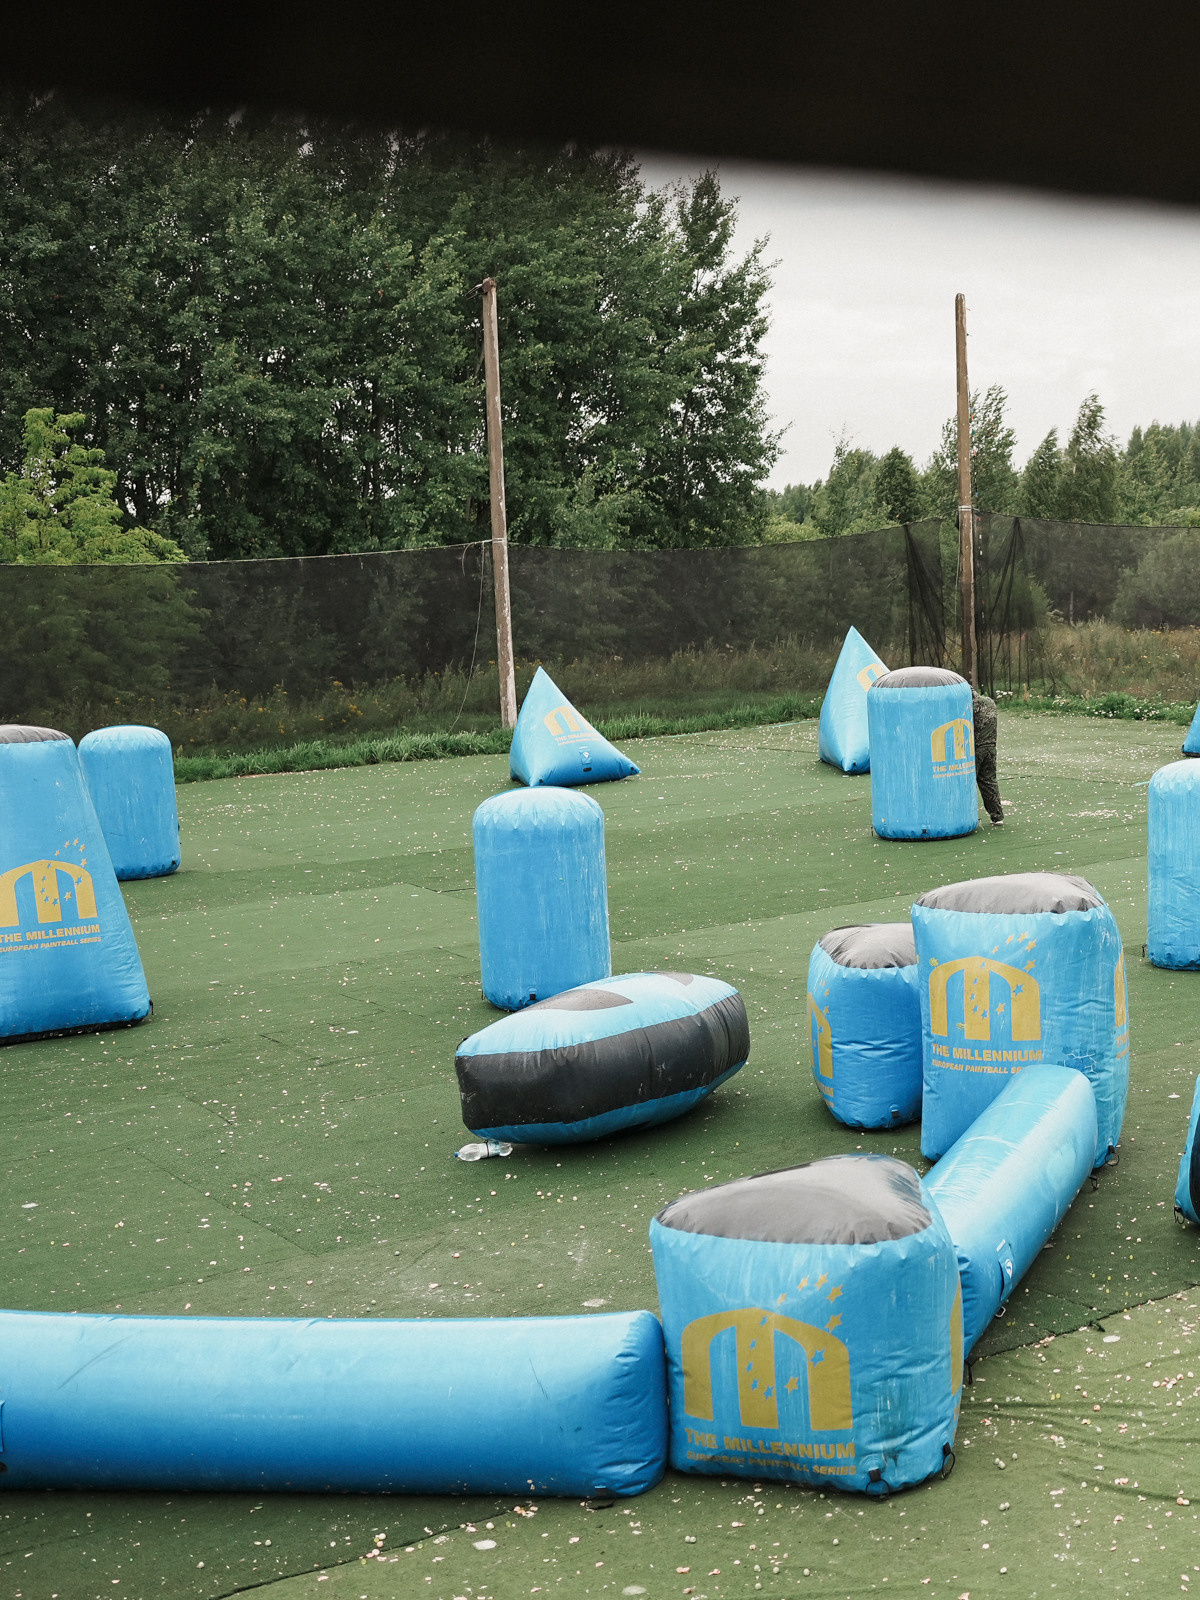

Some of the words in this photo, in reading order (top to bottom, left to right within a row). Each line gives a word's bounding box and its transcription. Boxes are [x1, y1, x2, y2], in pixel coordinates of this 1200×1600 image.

[26, 924, 101, 941] MILLENNIUM
[41, 939, 79, 949] PAINTBALL
[932, 1042, 950, 1058] THE
[952, 1047, 1043, 1062] MILLENNIUM
[932, 1058, 964, 1072] EUROPEAN
[965, 1064, 1009, 1074] PAINTBALL
[685, 1427, 719, 1449] THE
[723, 1436, 856, 1460] MILLENNIUM
[812, 1465, 857, 1476] SERIES
